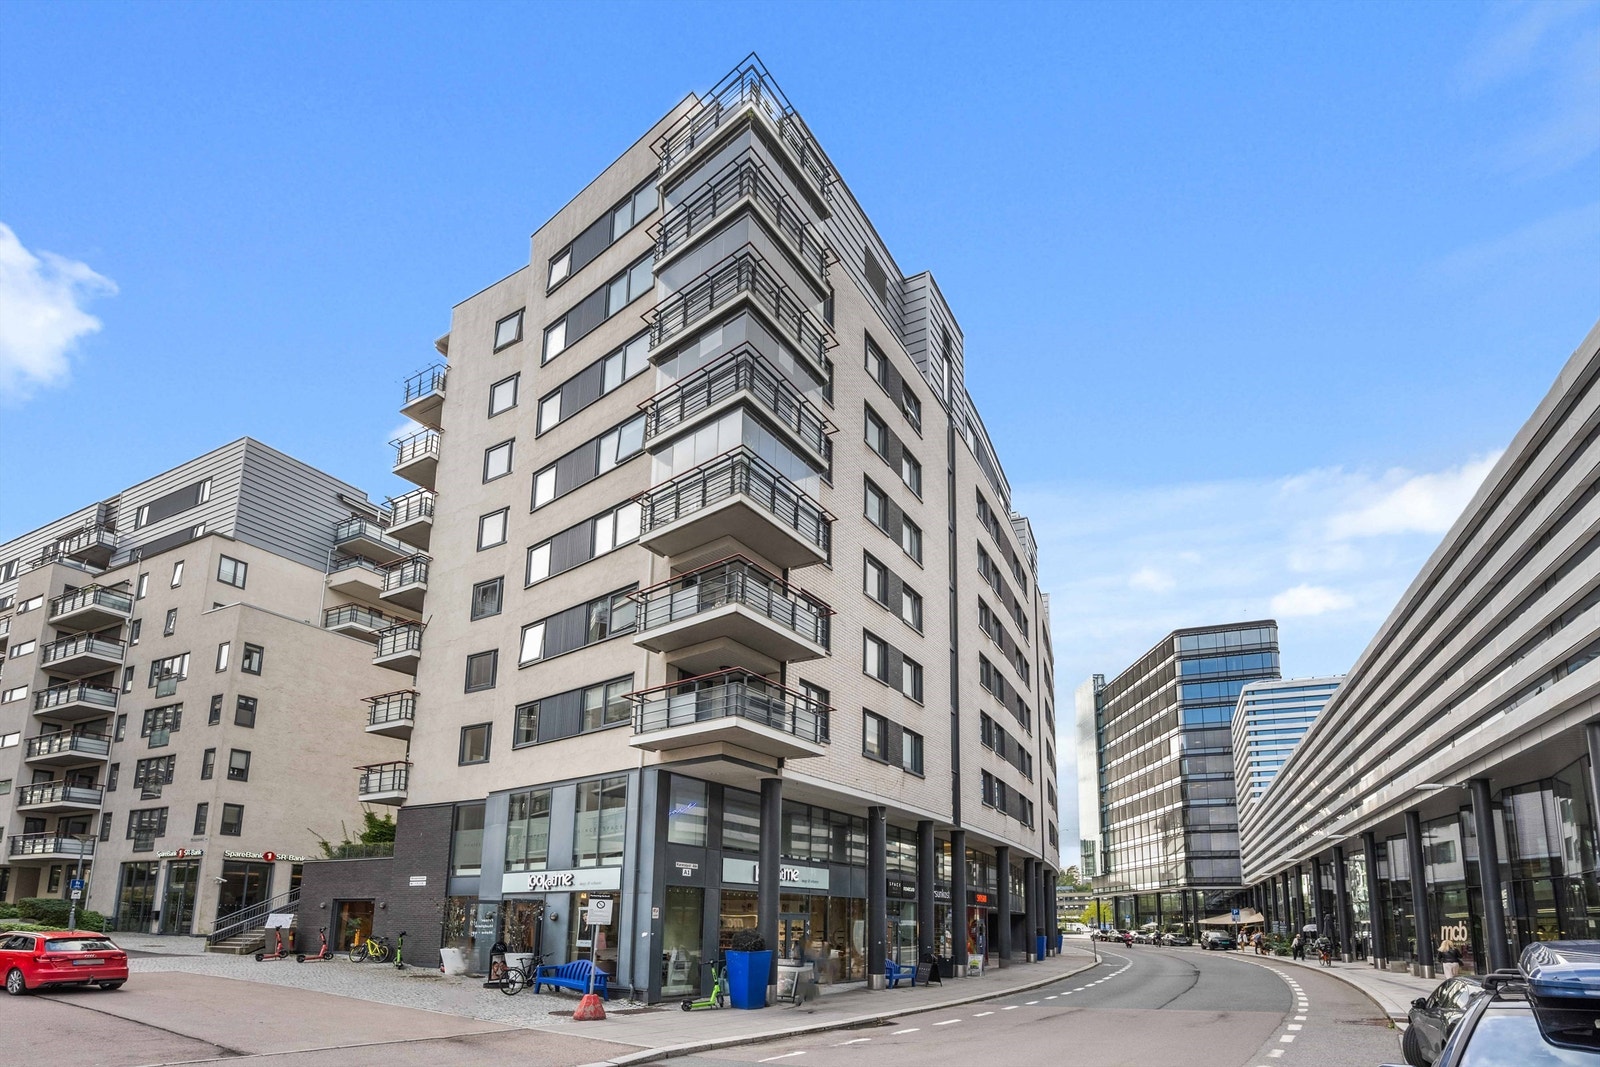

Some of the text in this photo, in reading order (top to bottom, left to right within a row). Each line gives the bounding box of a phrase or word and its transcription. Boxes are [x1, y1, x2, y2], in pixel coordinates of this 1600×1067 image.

[224, 851, 264, 860] SpareBank
[276, 854, 305, 863] SR-Bank
[1440, 920, 1468, 942] mcb
